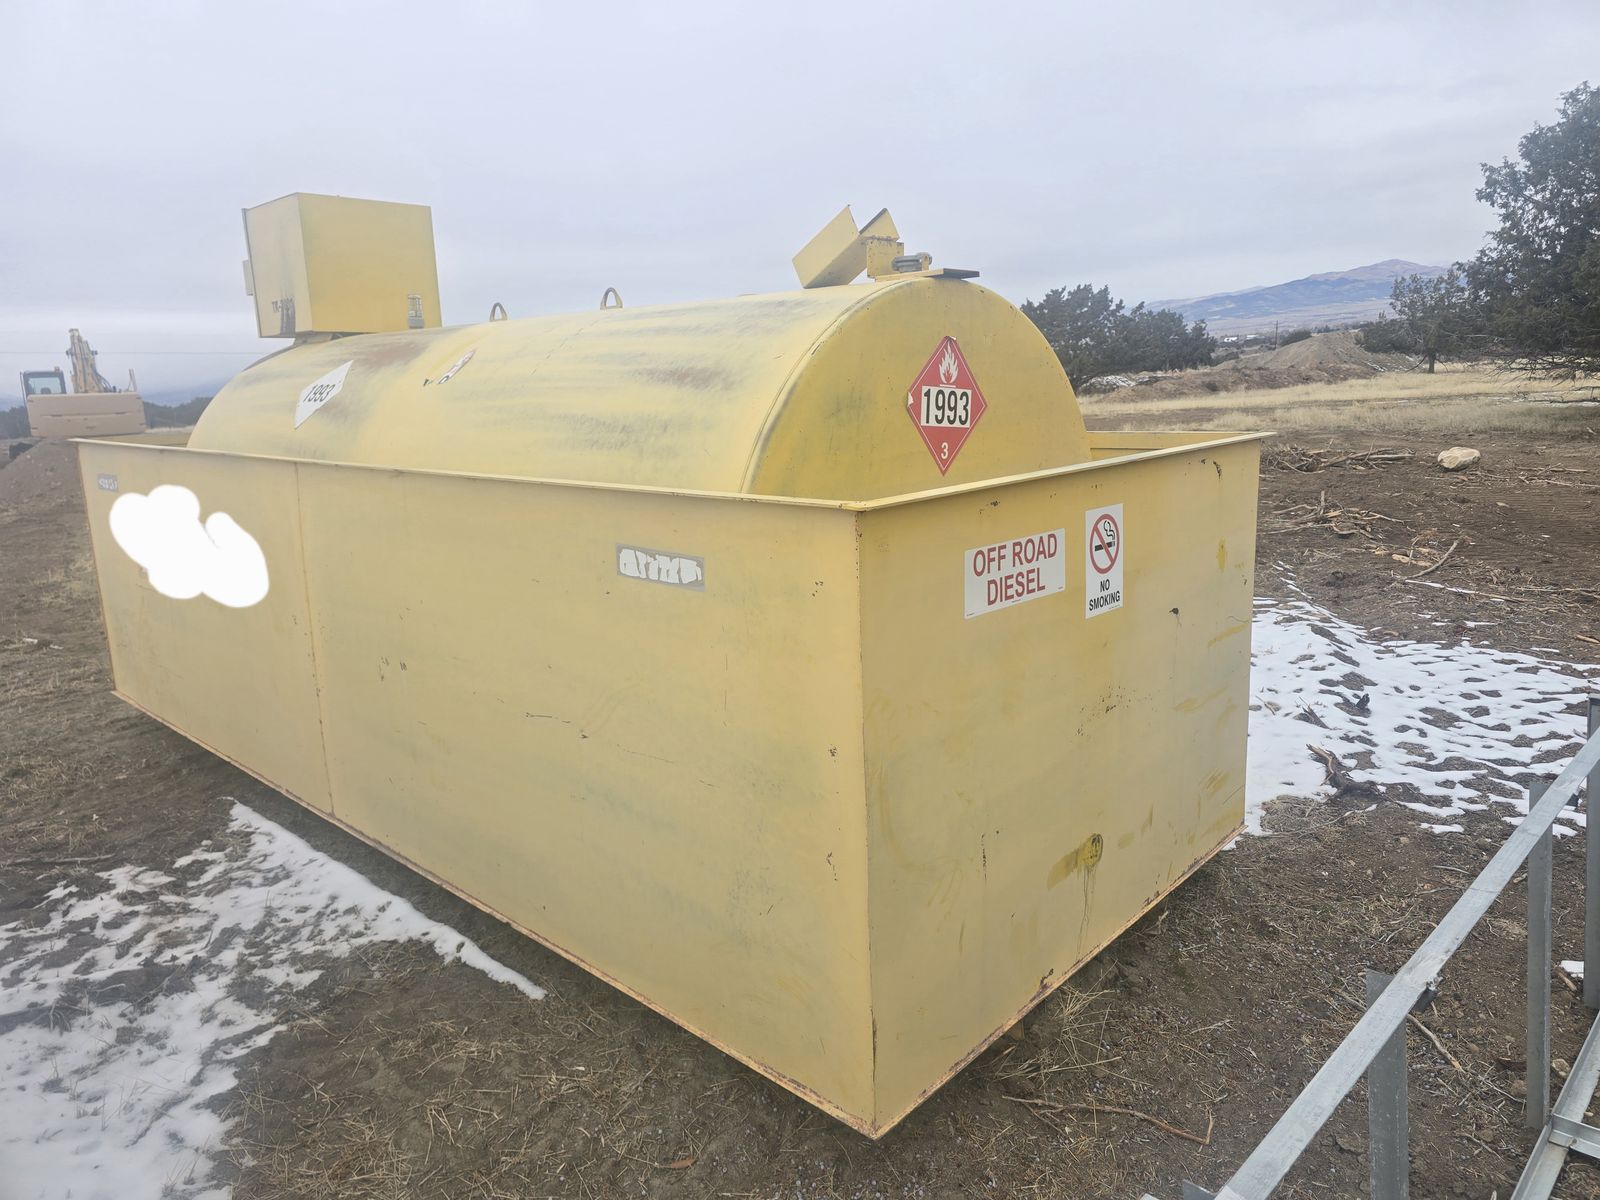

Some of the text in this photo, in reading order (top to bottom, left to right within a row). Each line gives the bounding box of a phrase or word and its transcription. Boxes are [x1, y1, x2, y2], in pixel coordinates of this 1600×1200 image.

[303, 384, 336, 402] 1993
[923, 388, 970, 425] 1993
[940, 442, 949, 460] 3
[973, 533, 1058, 577] OFF ROAD
[987, 567, 1046, 606] DIESEL
[1100, 579, 1110, 592] NO
[1089, 590, 1120, 611] SMOKING
